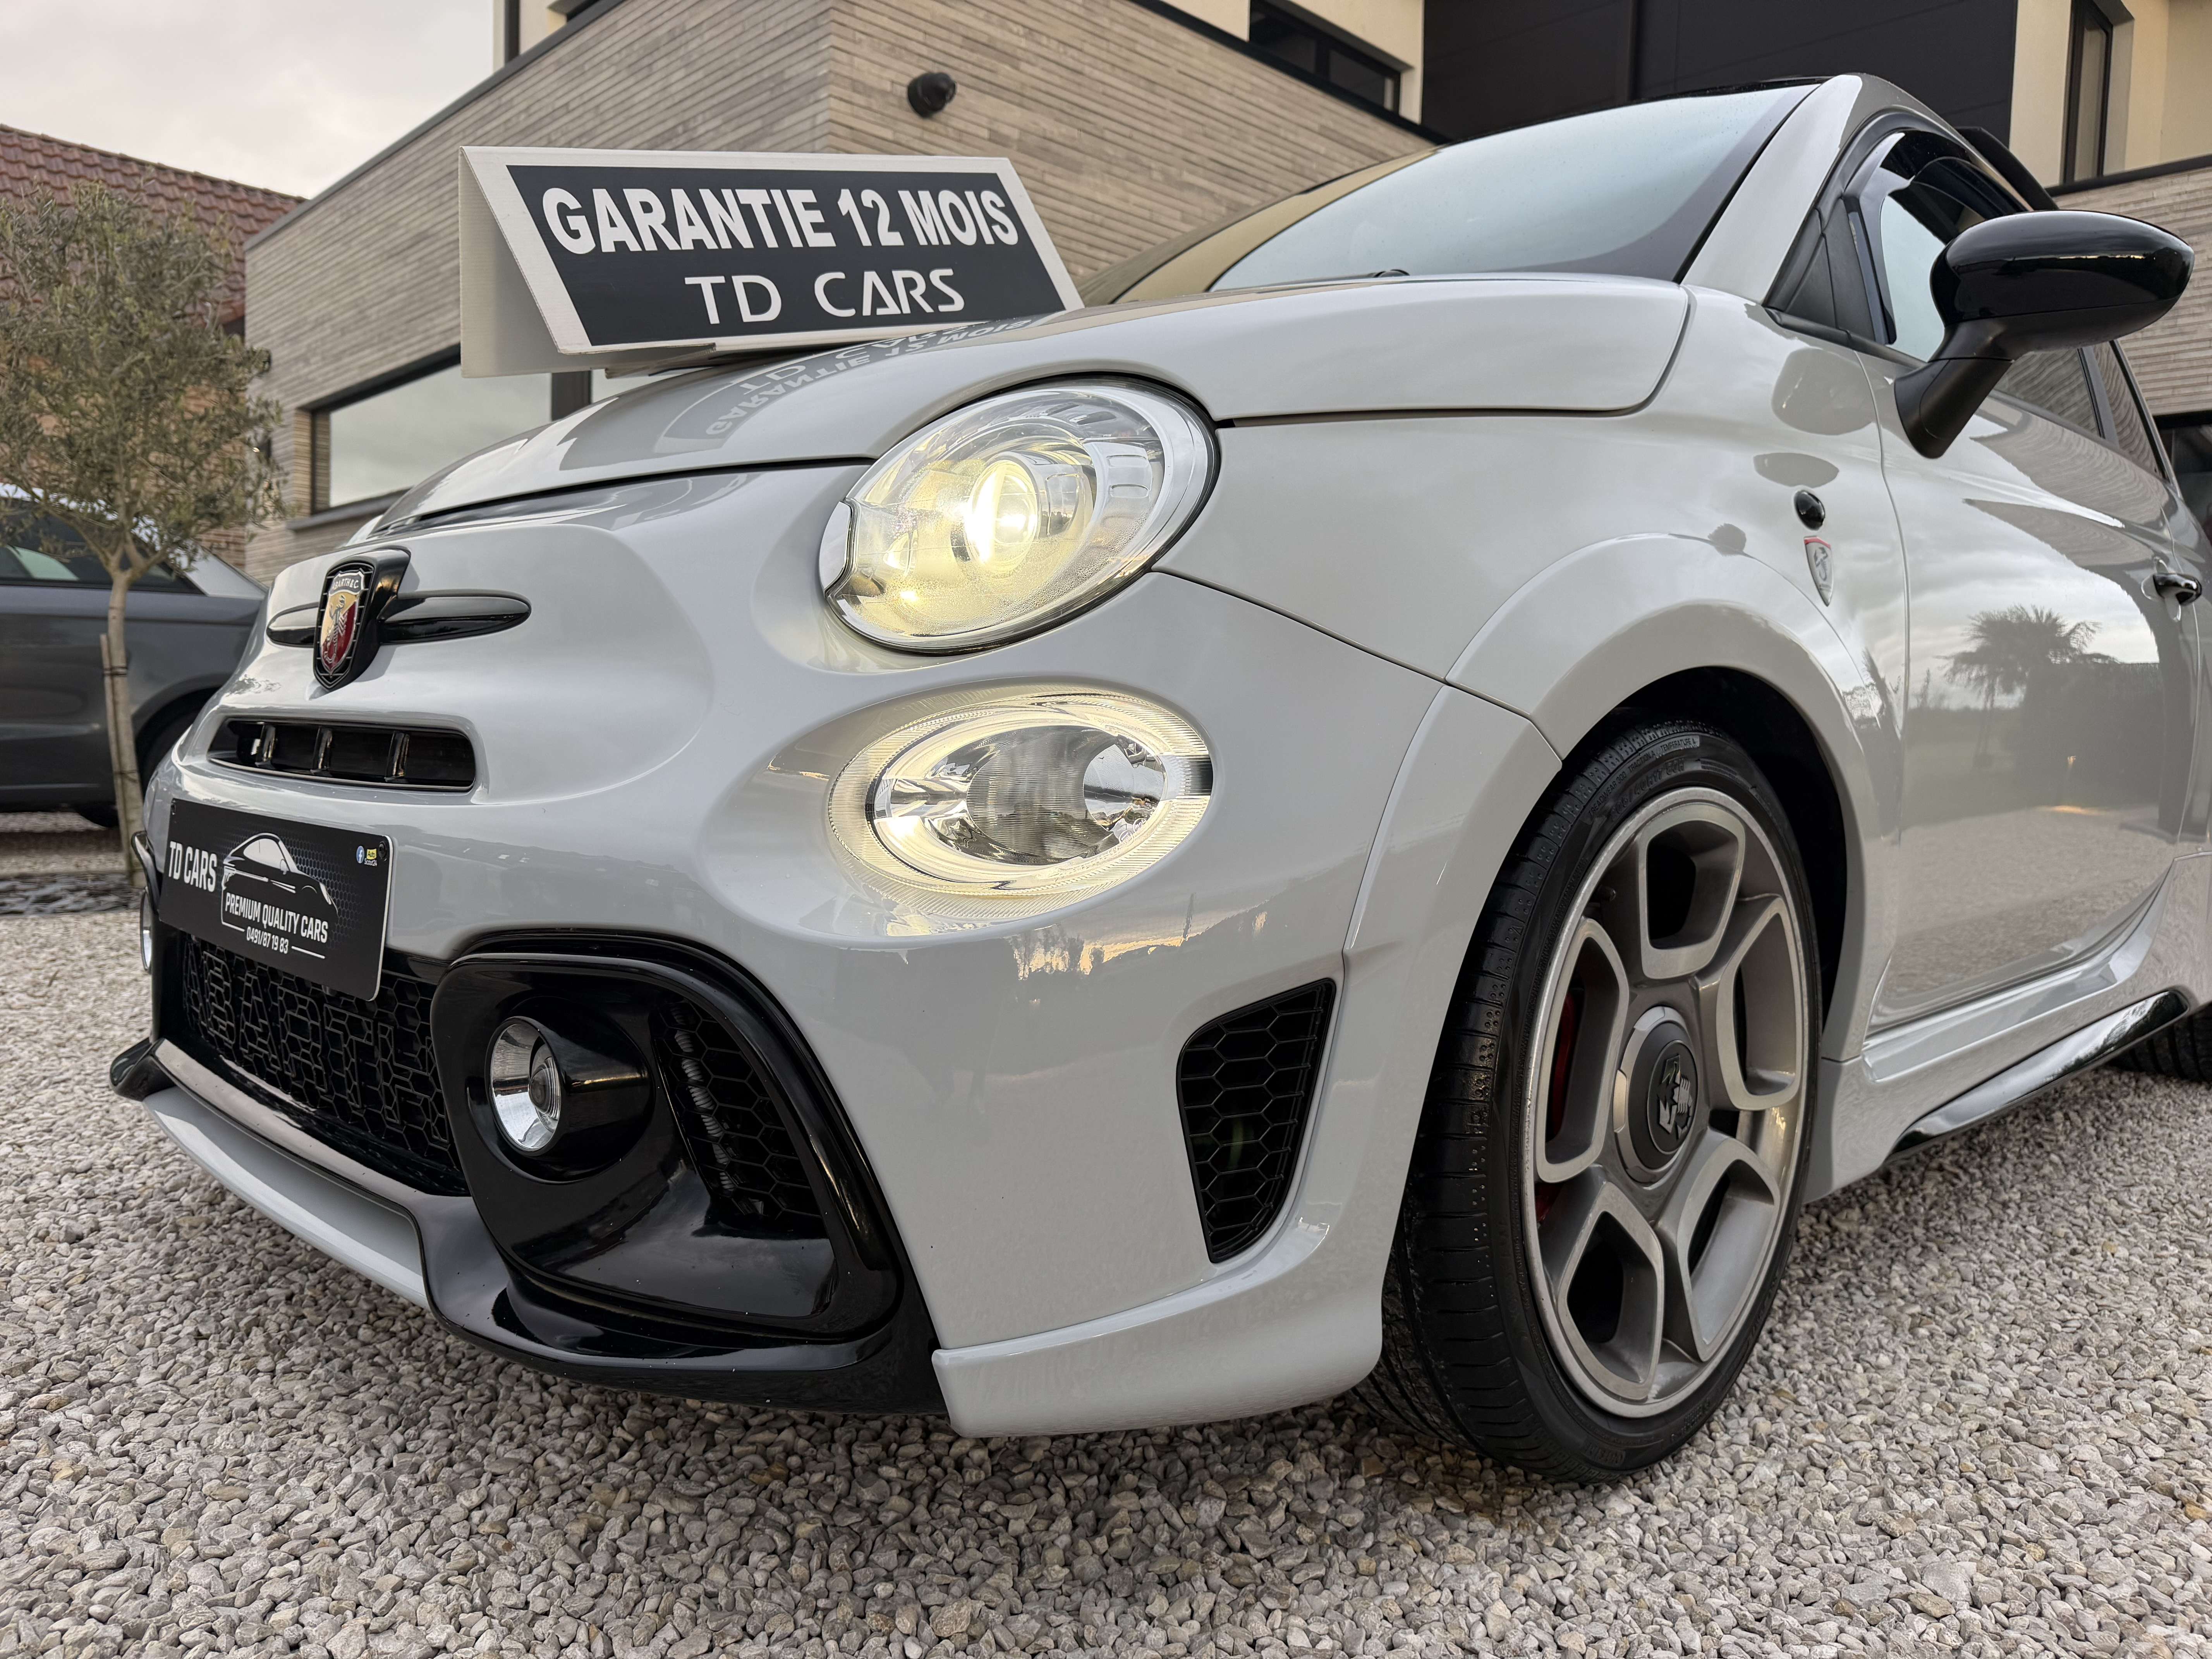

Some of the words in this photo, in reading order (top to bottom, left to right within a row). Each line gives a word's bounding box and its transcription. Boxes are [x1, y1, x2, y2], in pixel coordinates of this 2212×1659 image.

[542, 187, 836, 254] GARANTIE
[837, 189, 905, 246] 12
[898, 190, 1018, 246] MOIS
[684, 275, 782, 324] TD
[814, 269, 965, 317] CARS
[1588, 779, 1617, 816] TREADWEAR
[1616, 771, 1627, 785] 300
[1628, 752, 1652, 773] TRACTION
[168, 841, 183, 880] TD
[184, 846, 217, 892] CARS
[225, 892, 261, 923] PREMIUM
[262, 904, 300, 934] QUALITY
[301, 915, 328, 943] CARS
[247, 926, 271, 948] 0491/87
[272, 934, 279, 951] 19
[280, 937, 289, 954] 83
